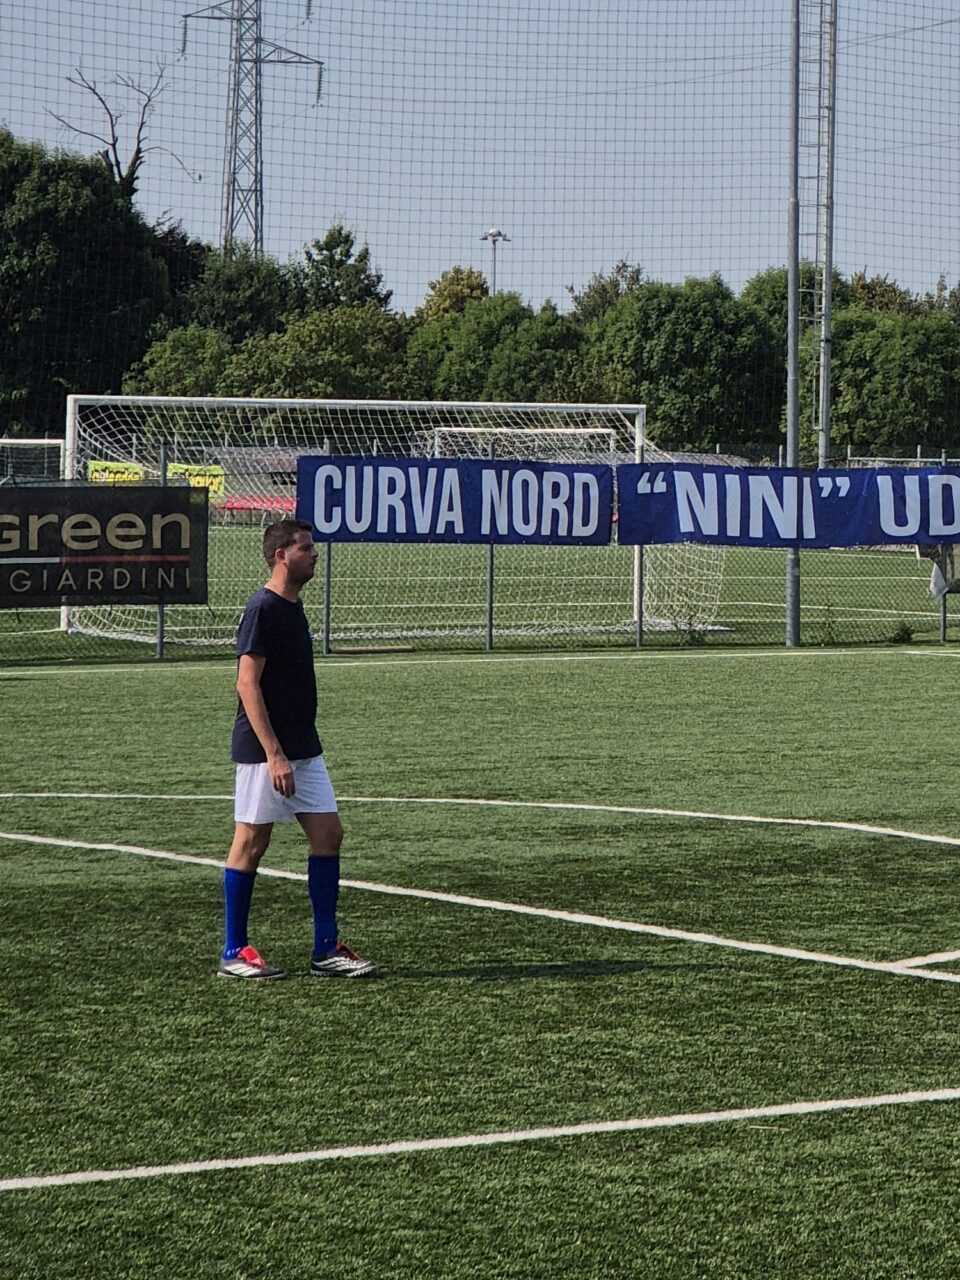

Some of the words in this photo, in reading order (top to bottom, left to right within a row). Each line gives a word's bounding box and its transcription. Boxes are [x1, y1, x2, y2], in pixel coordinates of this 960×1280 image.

[314, 464, 464, 534] CURVA
[481, 469, 600, 537] NORD
[9, 567, 192, 593] GIARDINI
